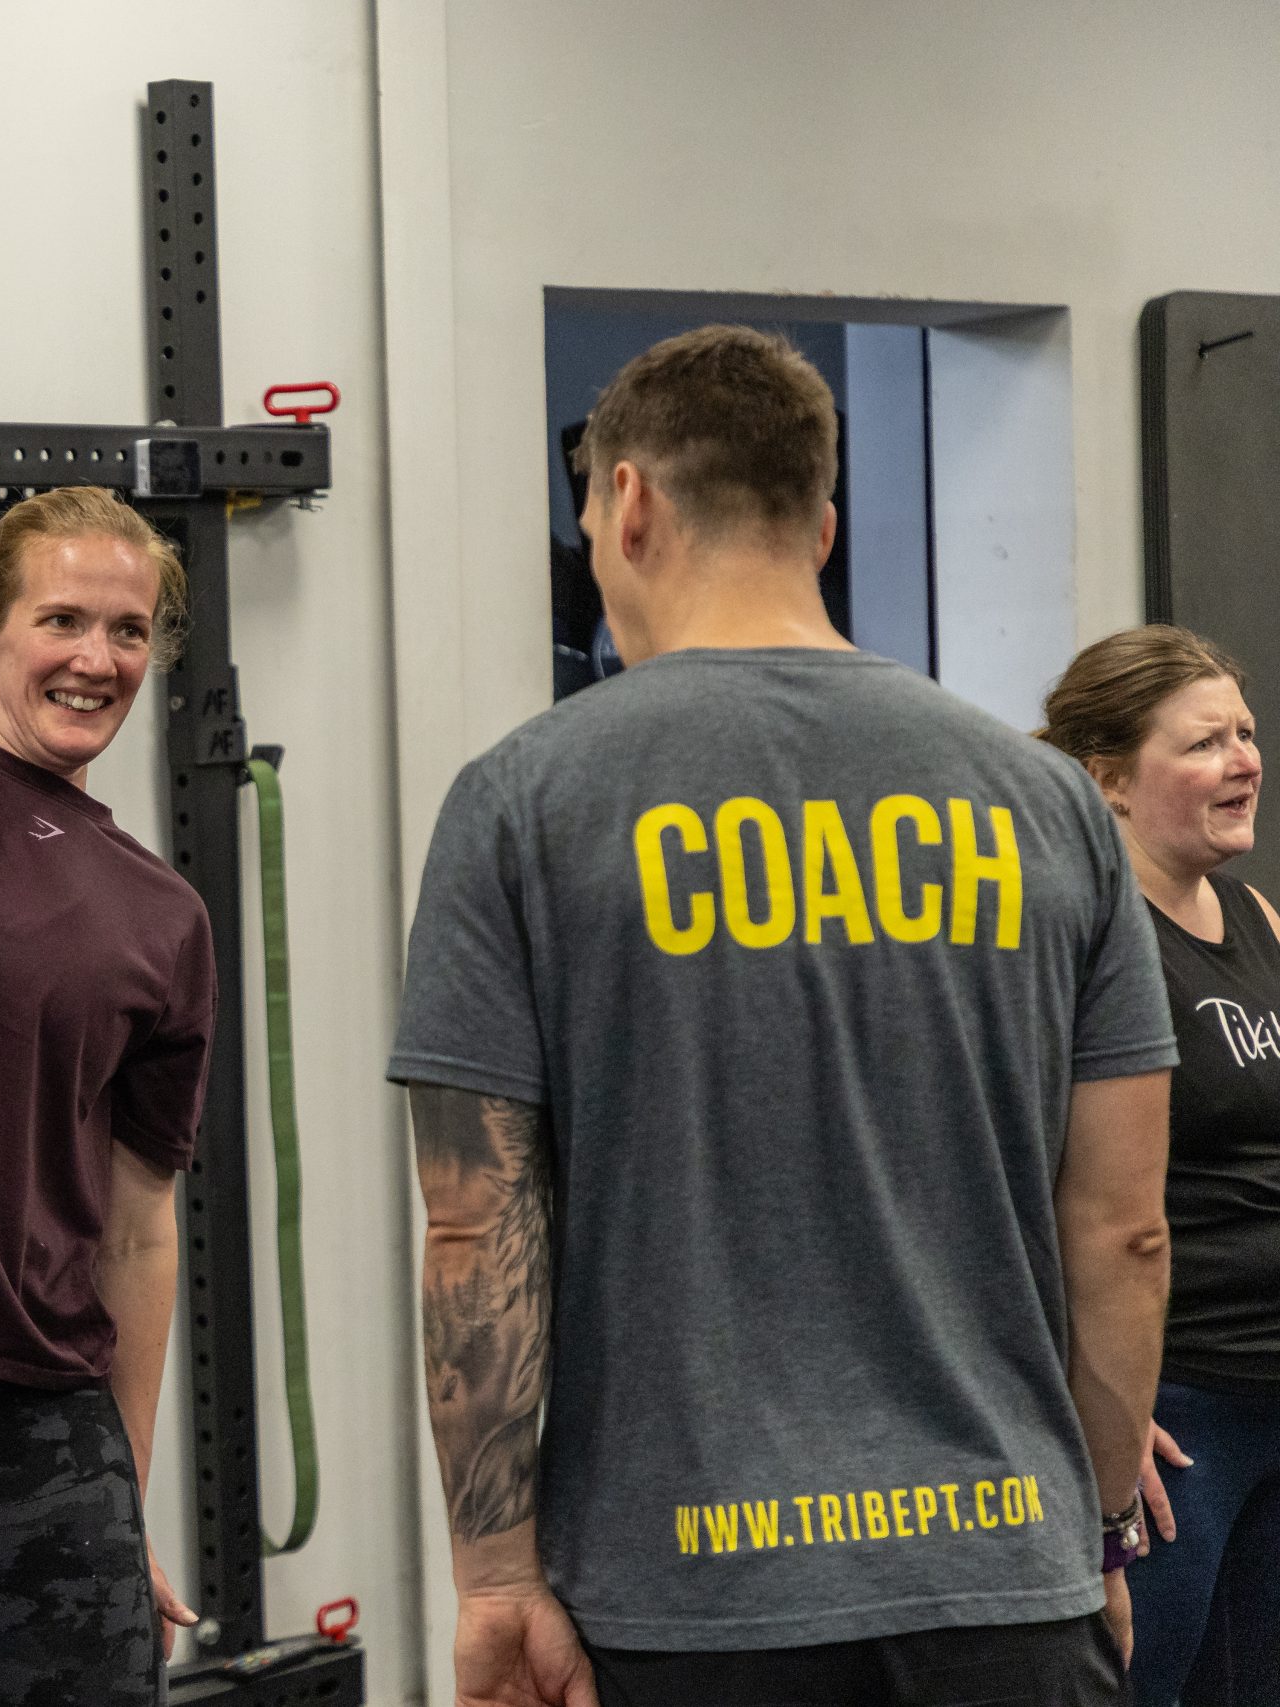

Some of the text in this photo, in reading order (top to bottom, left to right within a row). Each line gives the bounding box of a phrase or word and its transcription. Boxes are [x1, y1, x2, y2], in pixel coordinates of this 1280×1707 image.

[633, 794, 1023, 956] COACH
[1195, 998, 1280, 1068] Tiki
[676, 1474, 1044, 1554] WWW.TRIBEPT.COM
